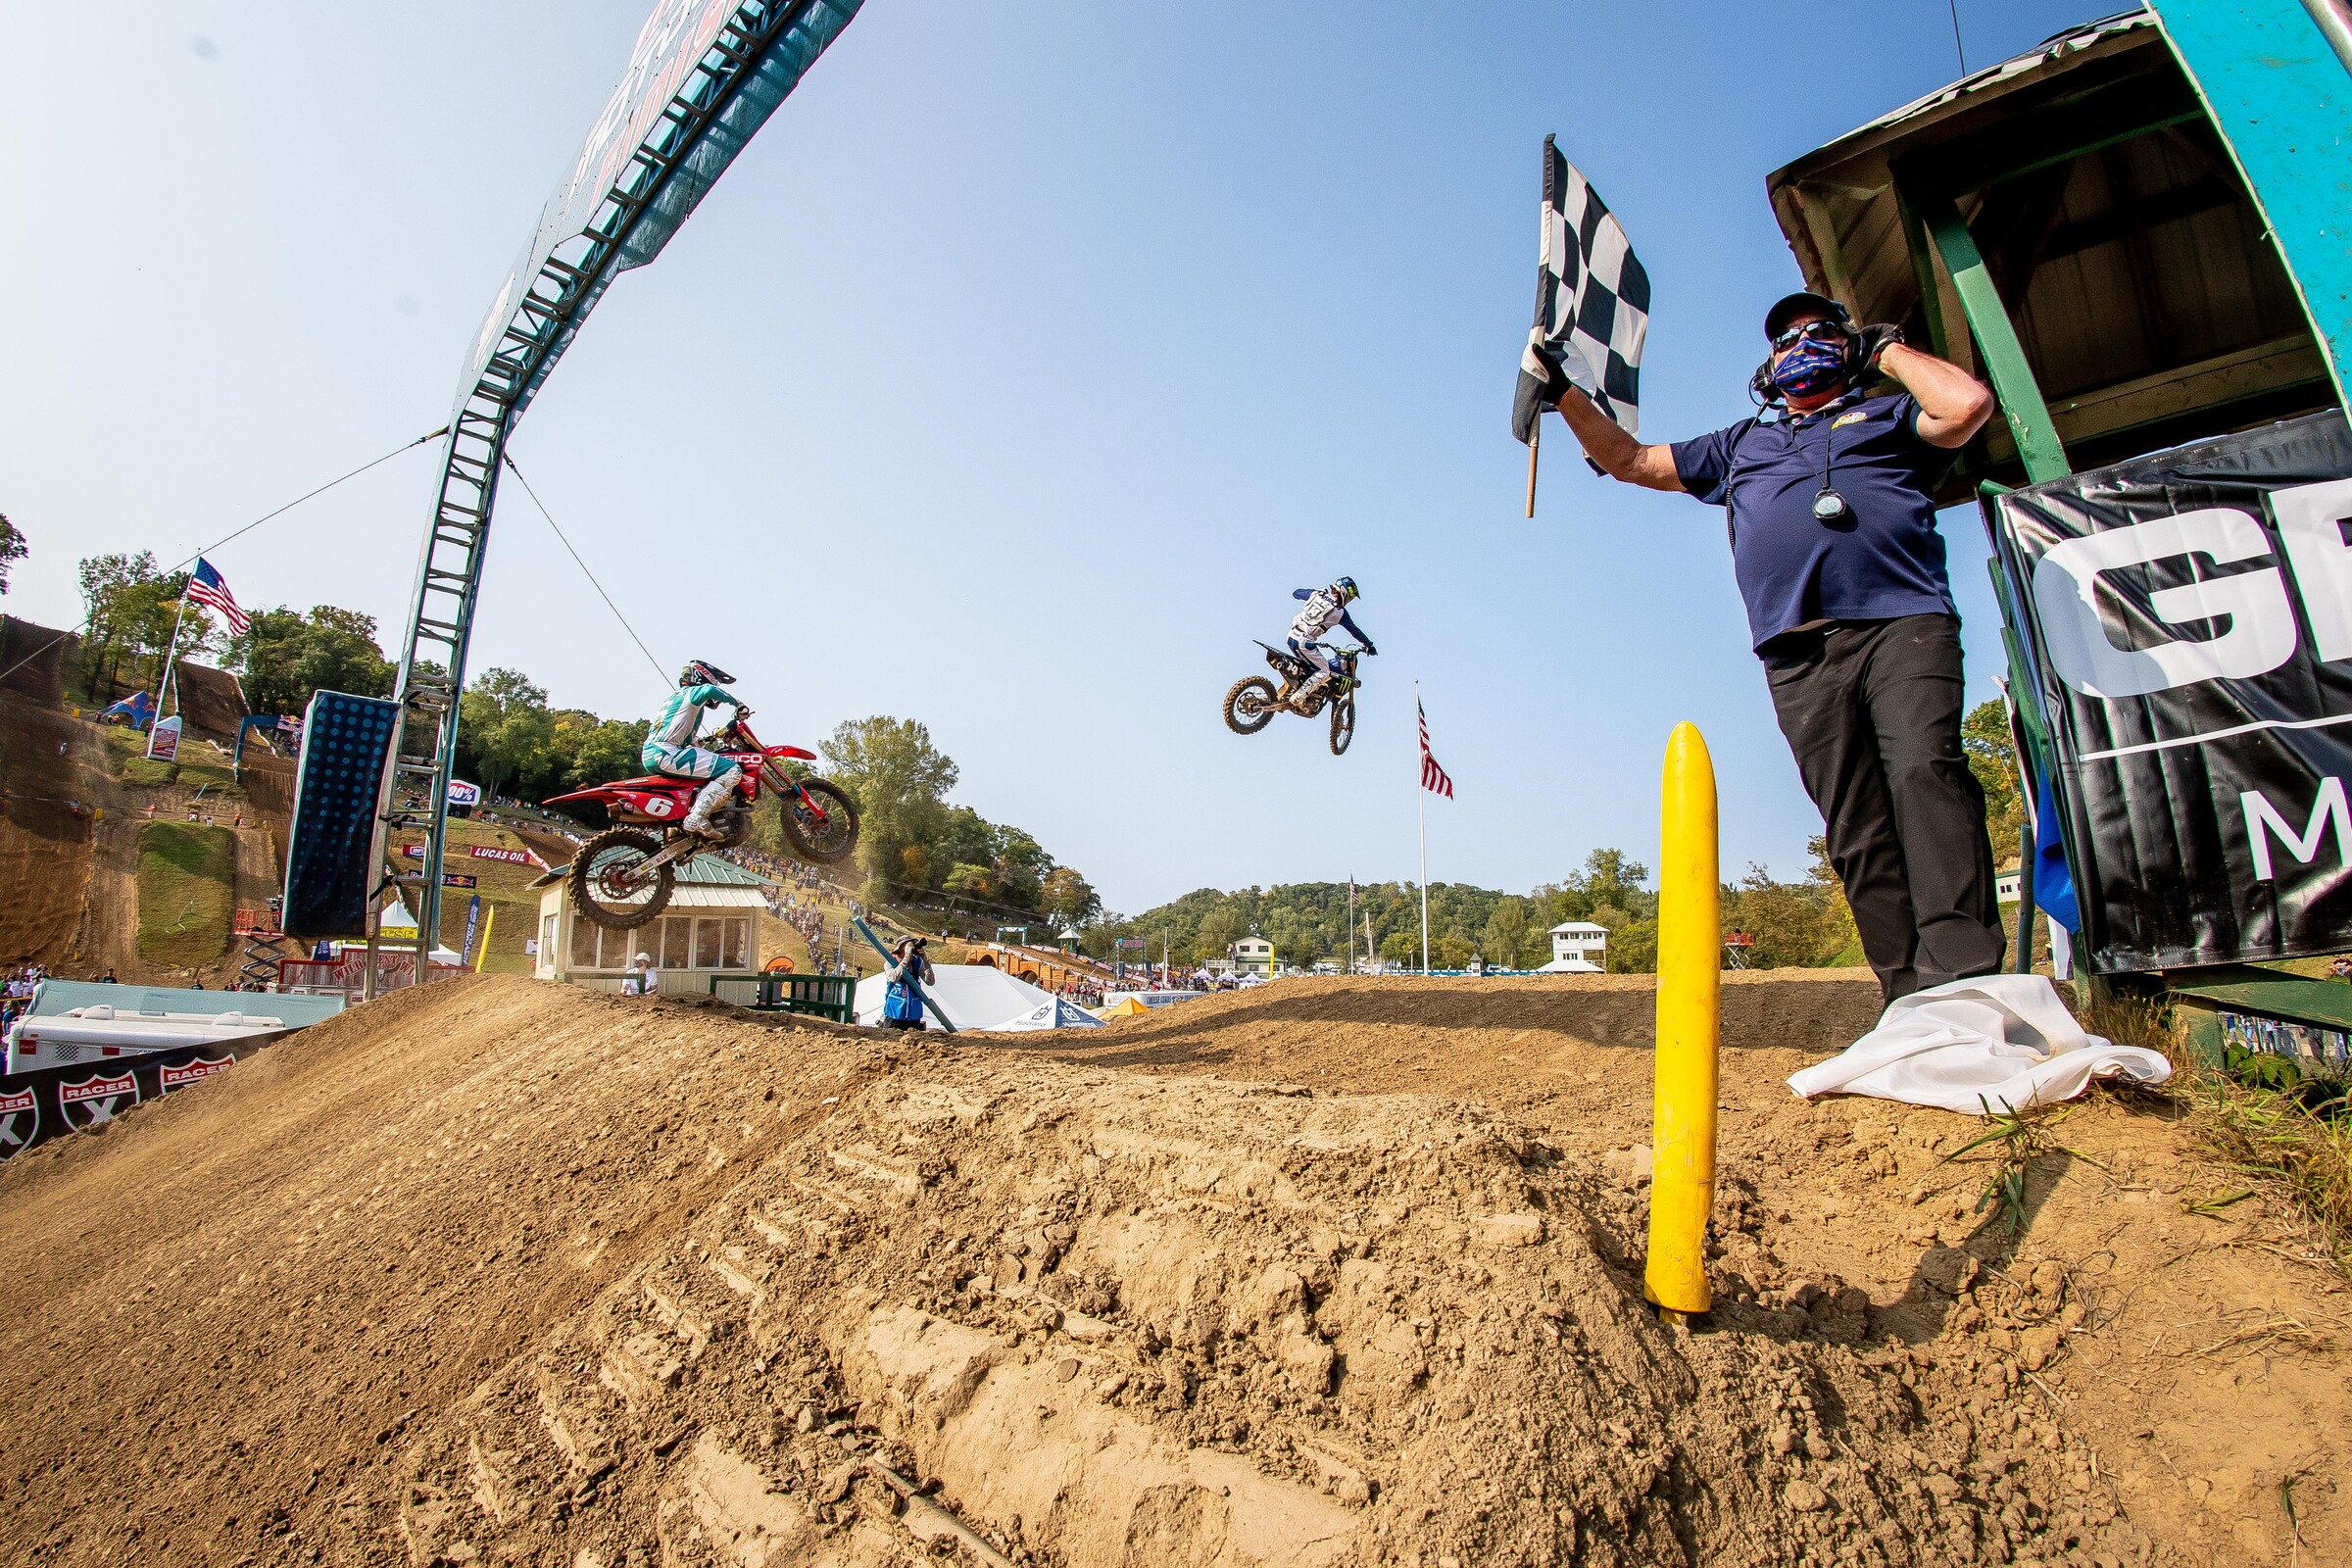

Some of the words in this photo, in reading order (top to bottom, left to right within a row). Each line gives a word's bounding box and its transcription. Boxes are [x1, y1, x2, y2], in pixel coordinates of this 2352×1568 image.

[589, 0, 743, 216] FINIS
[722, 755, 762, 763] EICO
[449, 785, 473, 801] 00%
[645, 798, 674, 816] 6
[474, 848, 508, 859] LUCAS
[509, 852, 525, 861] OIL
[378, 954, 398, 963] EST
[333, 958, 365, 980] WILD
[167, 1064, 232, 1082] RACER
[66, 1080, 131, 1099] RACER
[0, 1097, 30, 1111] CER
[82, 1096, 118, 1124] X
